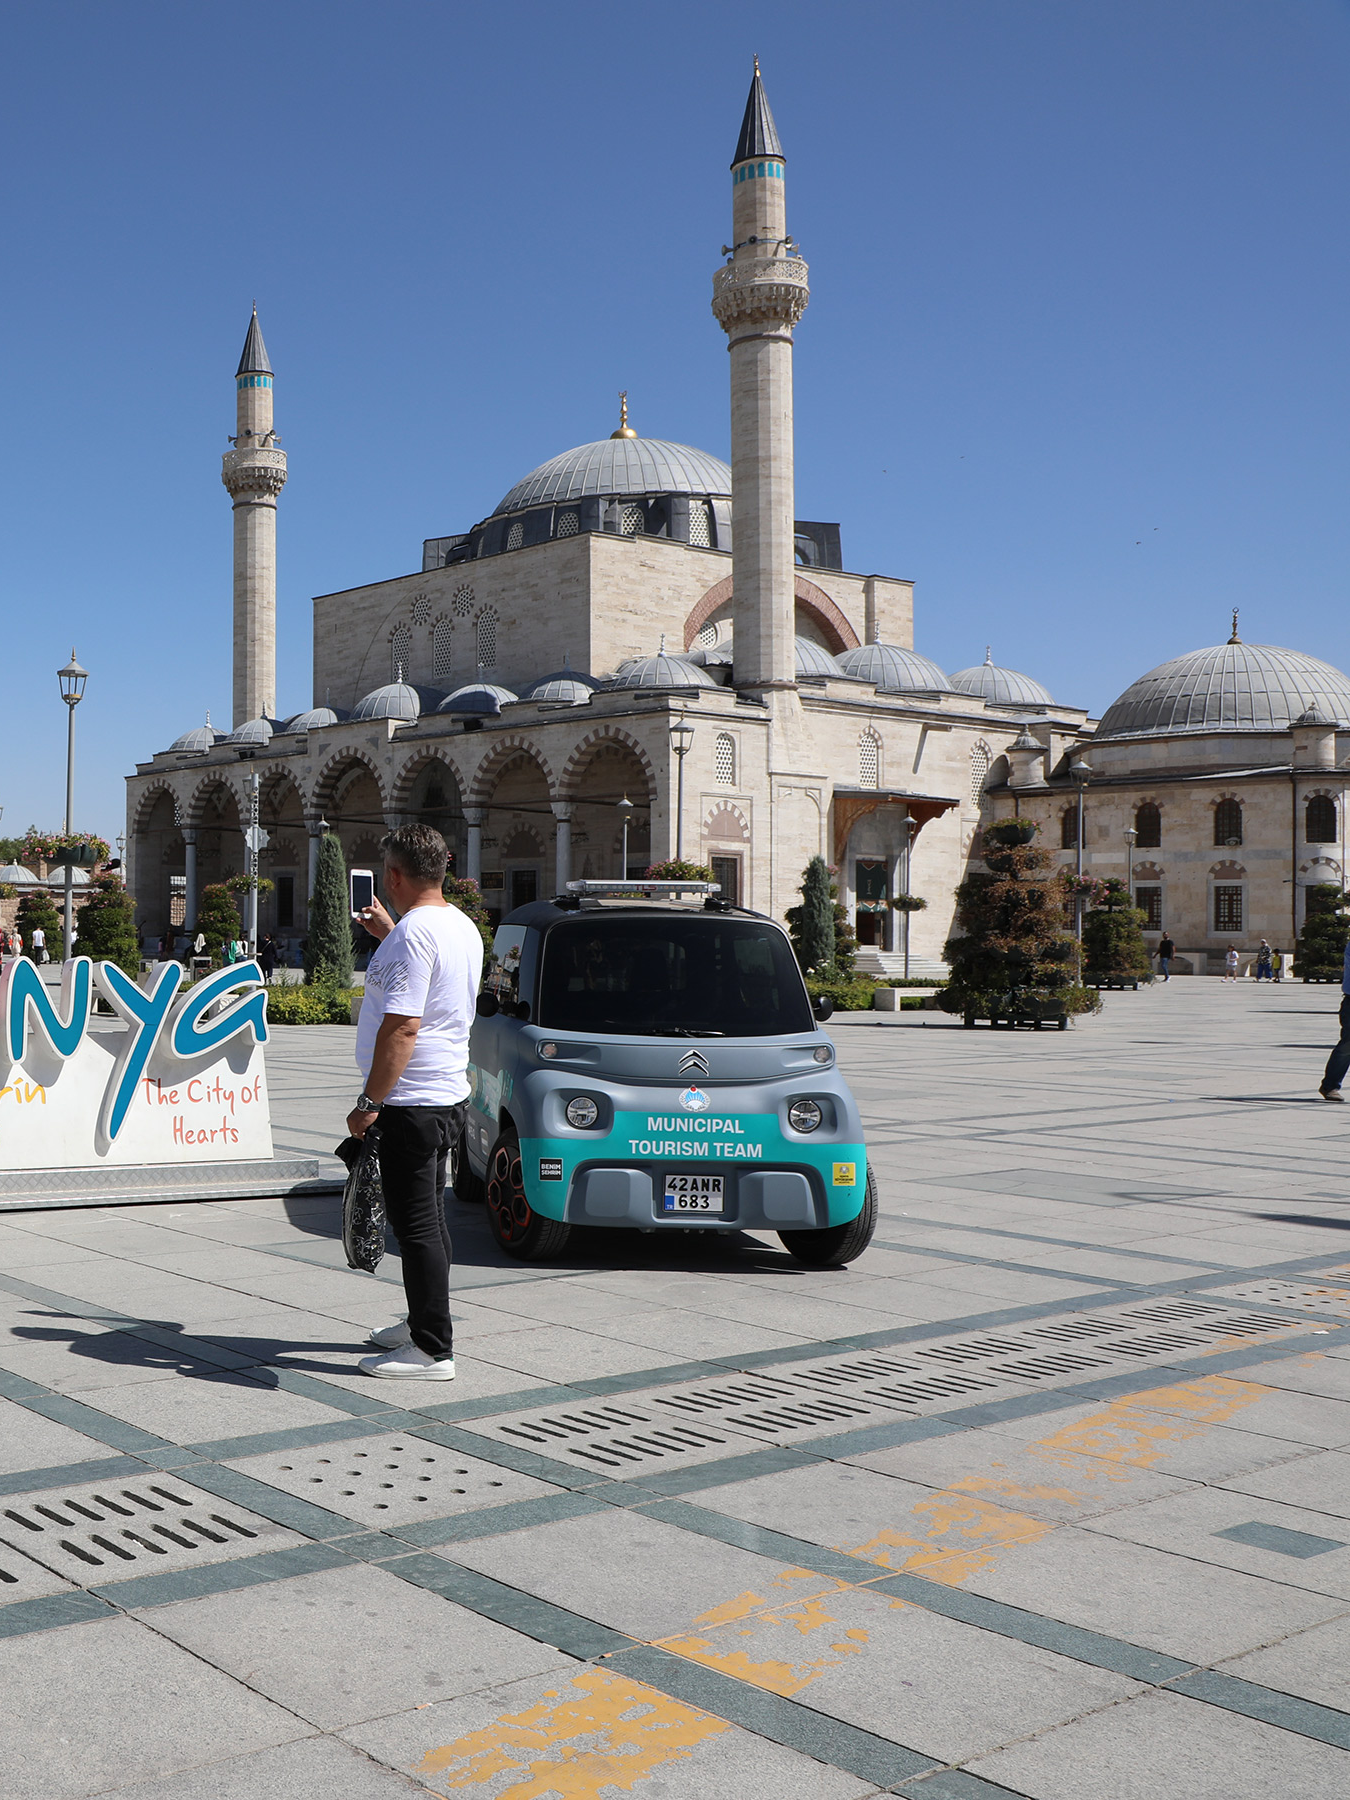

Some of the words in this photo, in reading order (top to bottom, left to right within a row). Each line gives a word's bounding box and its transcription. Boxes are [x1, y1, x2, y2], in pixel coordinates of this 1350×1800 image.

[141, 1077, 181, 1106] The
[187, 1075, 235, 1116] City
[240, 1074, 262, 1105] of
[172, 1115, 240, 1145] Hearts
[647, 1116, 745, 1134] MUNICIPAL
[628, 1139, 709, 1157] TOURISM
[713, 1142, 763, 1159] TEAM
[678, 1194, 710, 1209] 683
